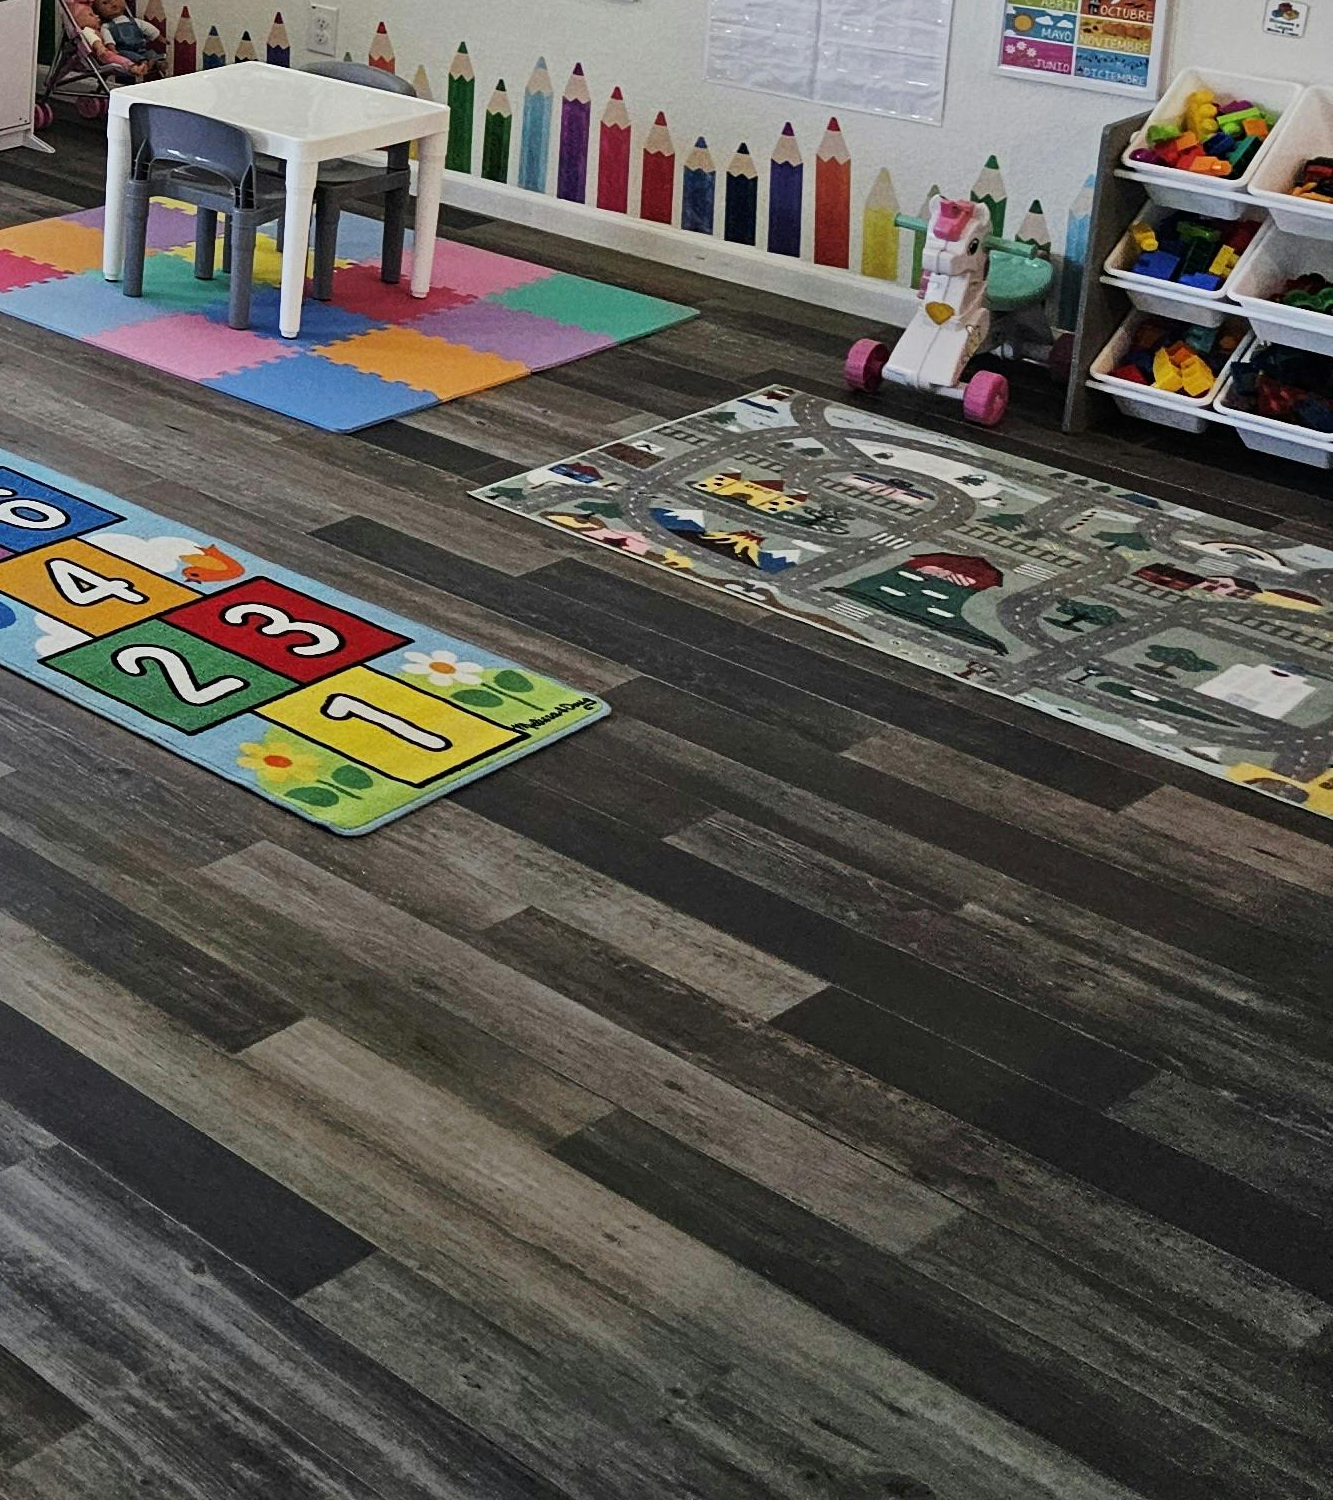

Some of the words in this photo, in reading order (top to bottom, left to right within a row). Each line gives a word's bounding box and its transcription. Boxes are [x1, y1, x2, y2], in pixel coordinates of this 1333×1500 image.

[1100, 5, 1154, 23] OCTUBRE
[1041, 28, 1073, 41] MAYO
[1079, 33, 1151, 52] NOVIEMBRE
[1034, 58, 1071, 73] JUNIO
[1082, 67, 1147, 86] DICIEMBRE
[47, 556, 149, 607] 4
[221, 600, 344, 658] 3
[114, 642, 247, 707] 2
[326, 692, 450, 754] 1
